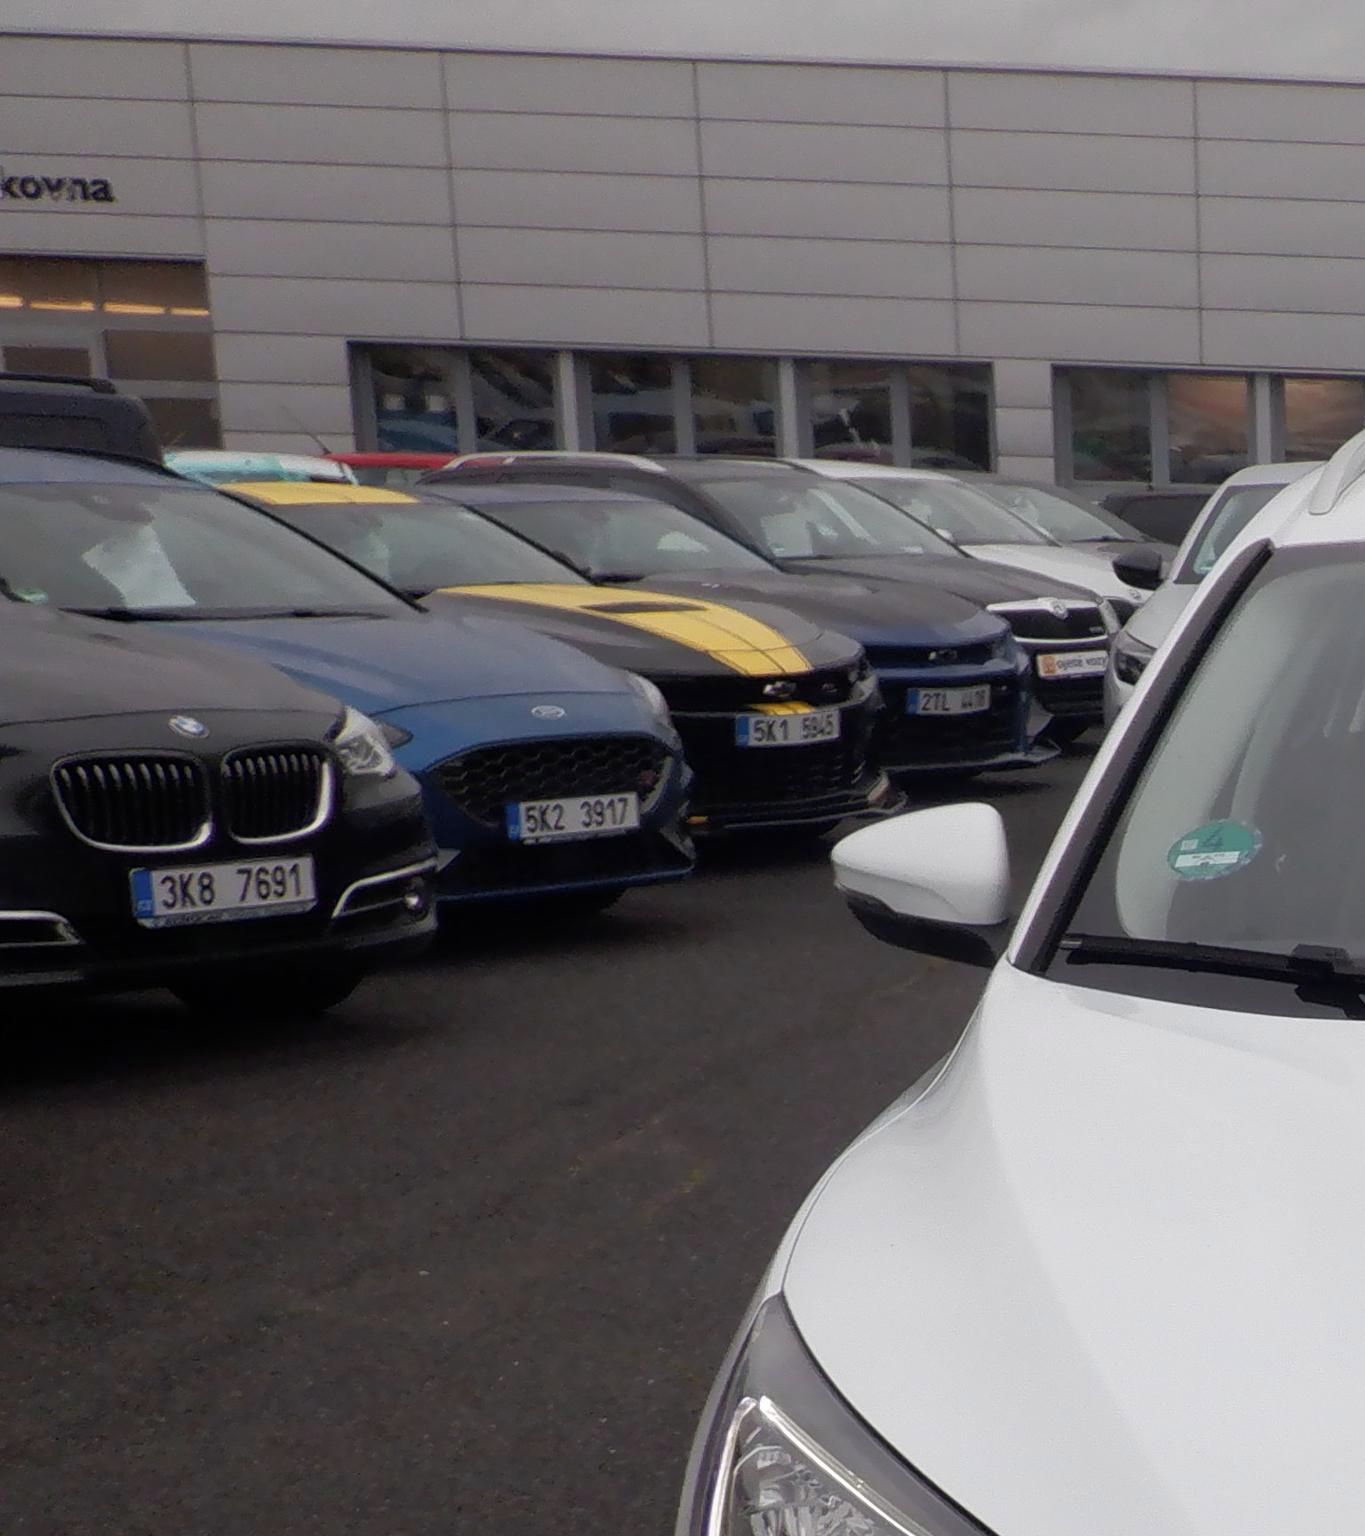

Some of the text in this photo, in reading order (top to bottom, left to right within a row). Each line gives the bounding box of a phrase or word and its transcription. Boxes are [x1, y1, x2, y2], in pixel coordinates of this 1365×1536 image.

[753, 719, 789, 742] 5K1
[525, 797, 629, 833] 5K2 3917
[160, 863, 302, 909] 3K8 7691
